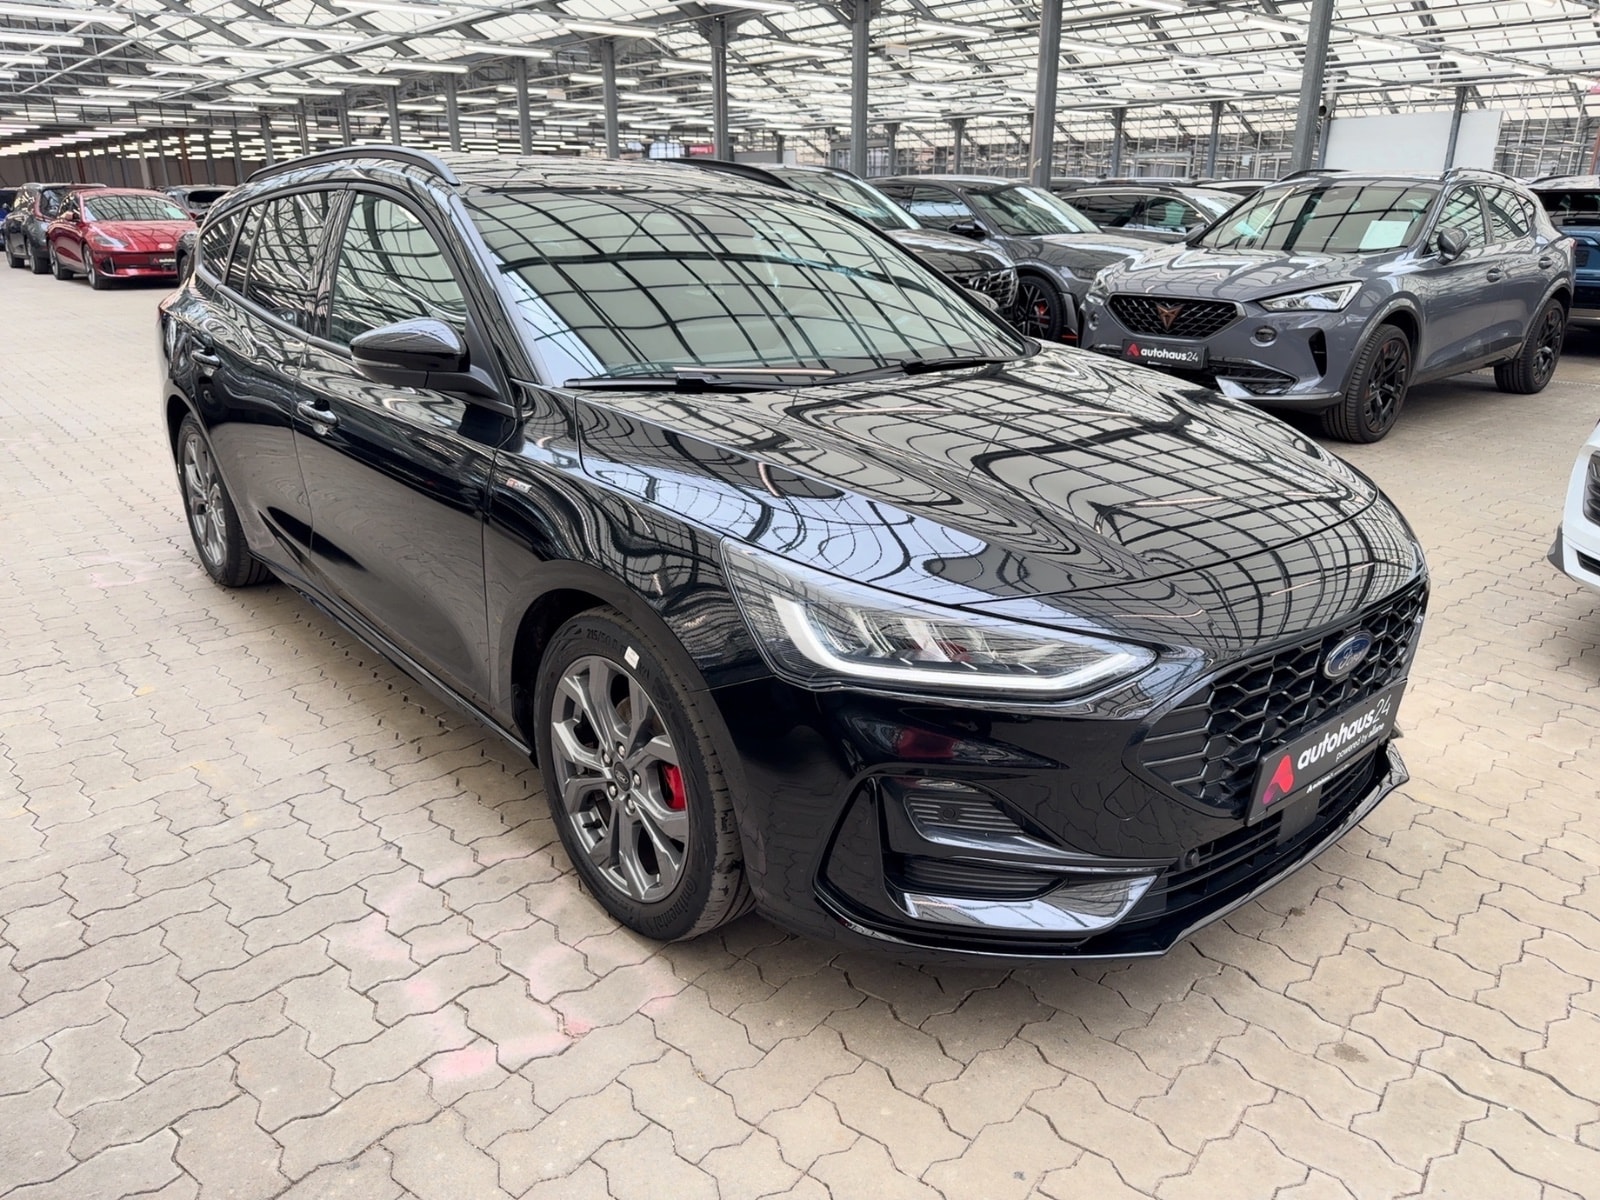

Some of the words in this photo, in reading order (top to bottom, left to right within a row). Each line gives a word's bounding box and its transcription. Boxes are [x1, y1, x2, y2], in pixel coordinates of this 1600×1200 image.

[1141, 347, 1199, 362] autohaus24
[1297, 694, 1392, 770] autohaus24
[653, 877, 698, 933] Continental
